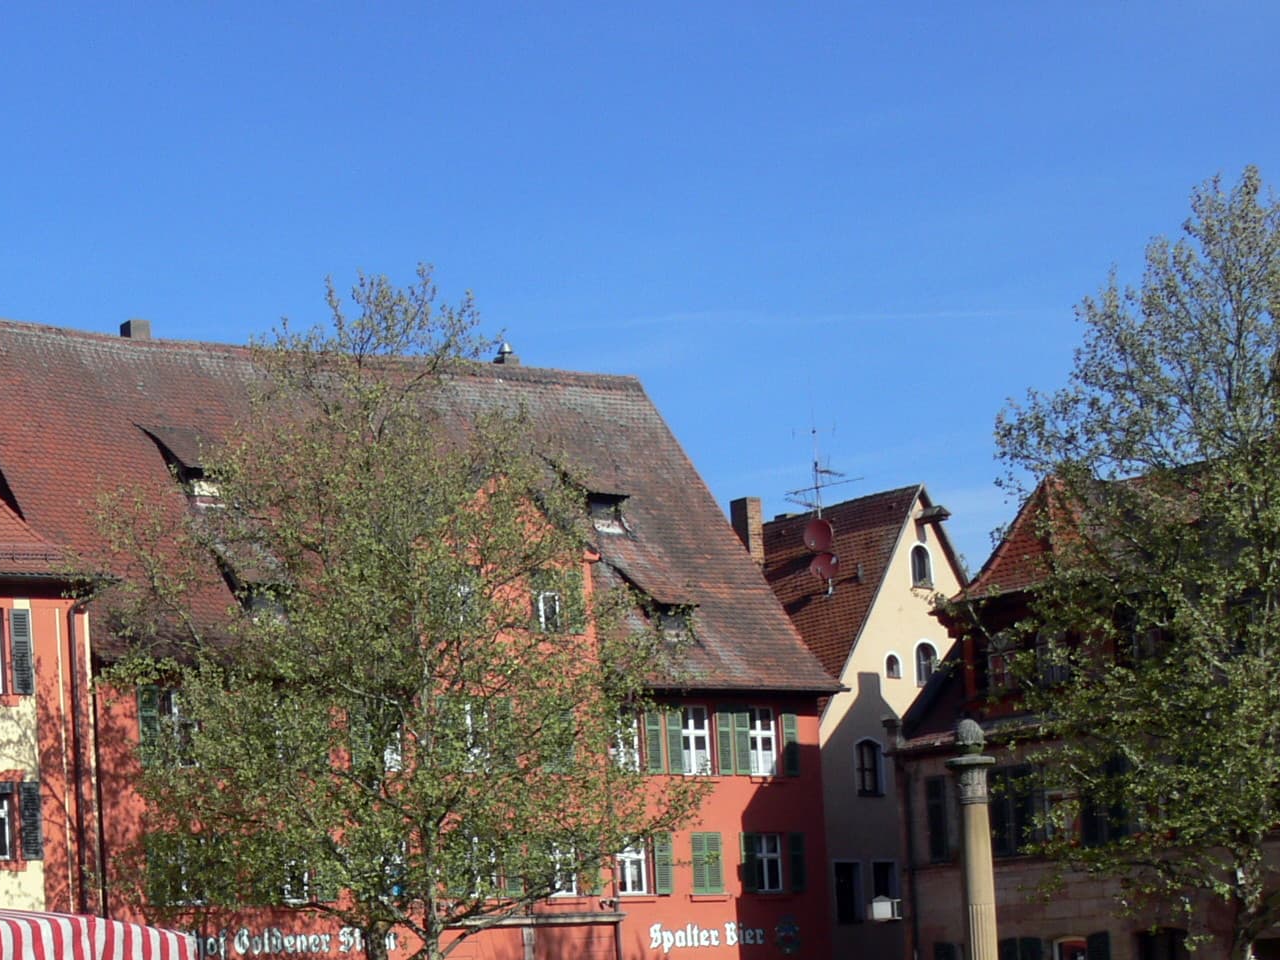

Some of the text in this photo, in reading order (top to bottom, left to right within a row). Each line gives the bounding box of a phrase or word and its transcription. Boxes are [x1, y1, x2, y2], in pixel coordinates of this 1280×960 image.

[234, 927, 331, 956] Goldener
[338, 925, 398, 954] Stn
[649, 921, 766, 954] Spalter Bier
